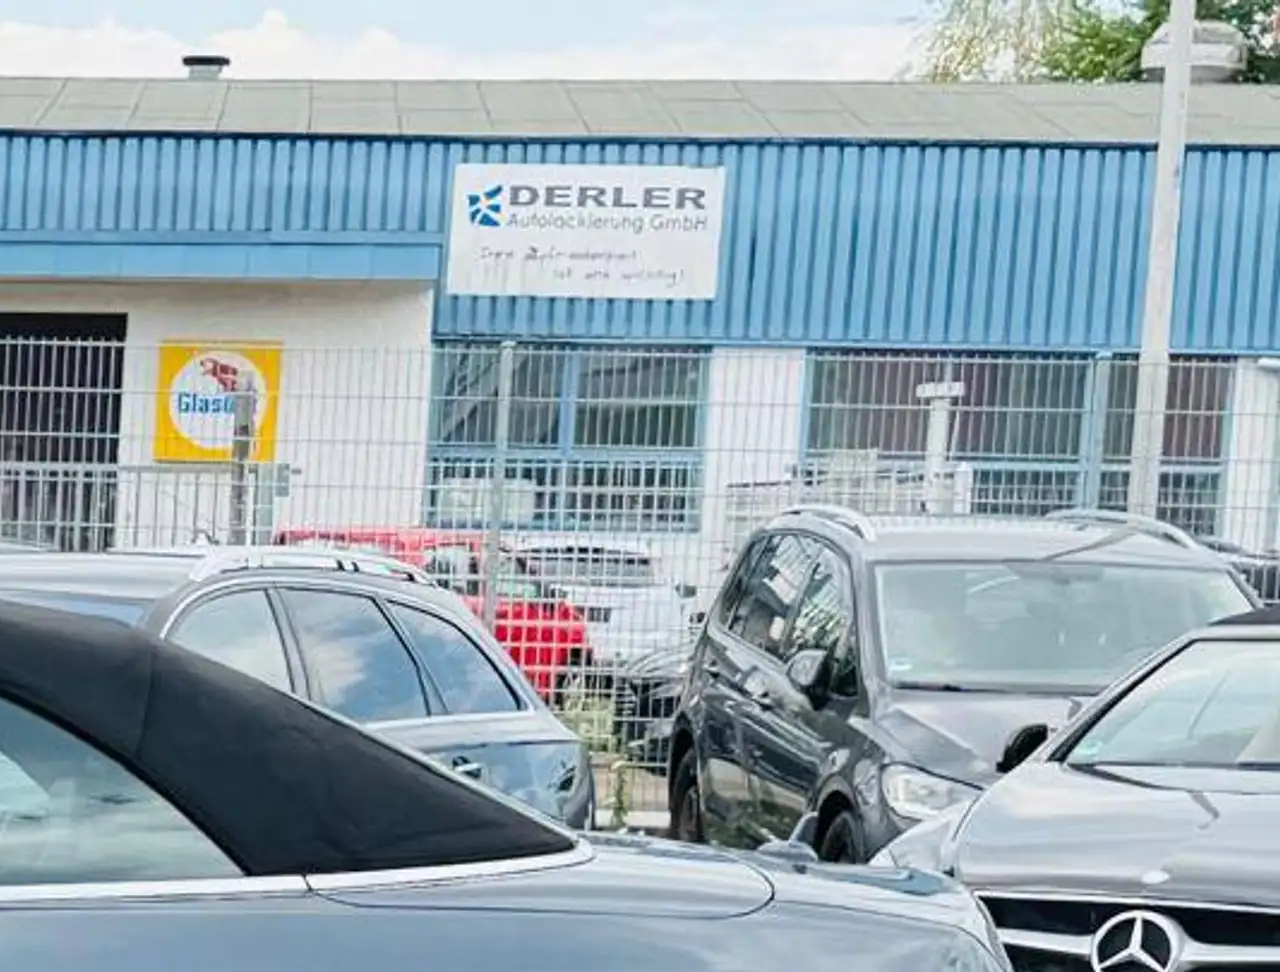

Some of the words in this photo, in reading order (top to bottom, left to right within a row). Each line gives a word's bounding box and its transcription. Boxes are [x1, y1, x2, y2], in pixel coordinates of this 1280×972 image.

[509, 184, 706, 210] DERLER
[506, 213, 642, 235] Autolackierung
[651, 214, 708, 231] GmbH
[177, 391, 238, 414] Glasu
